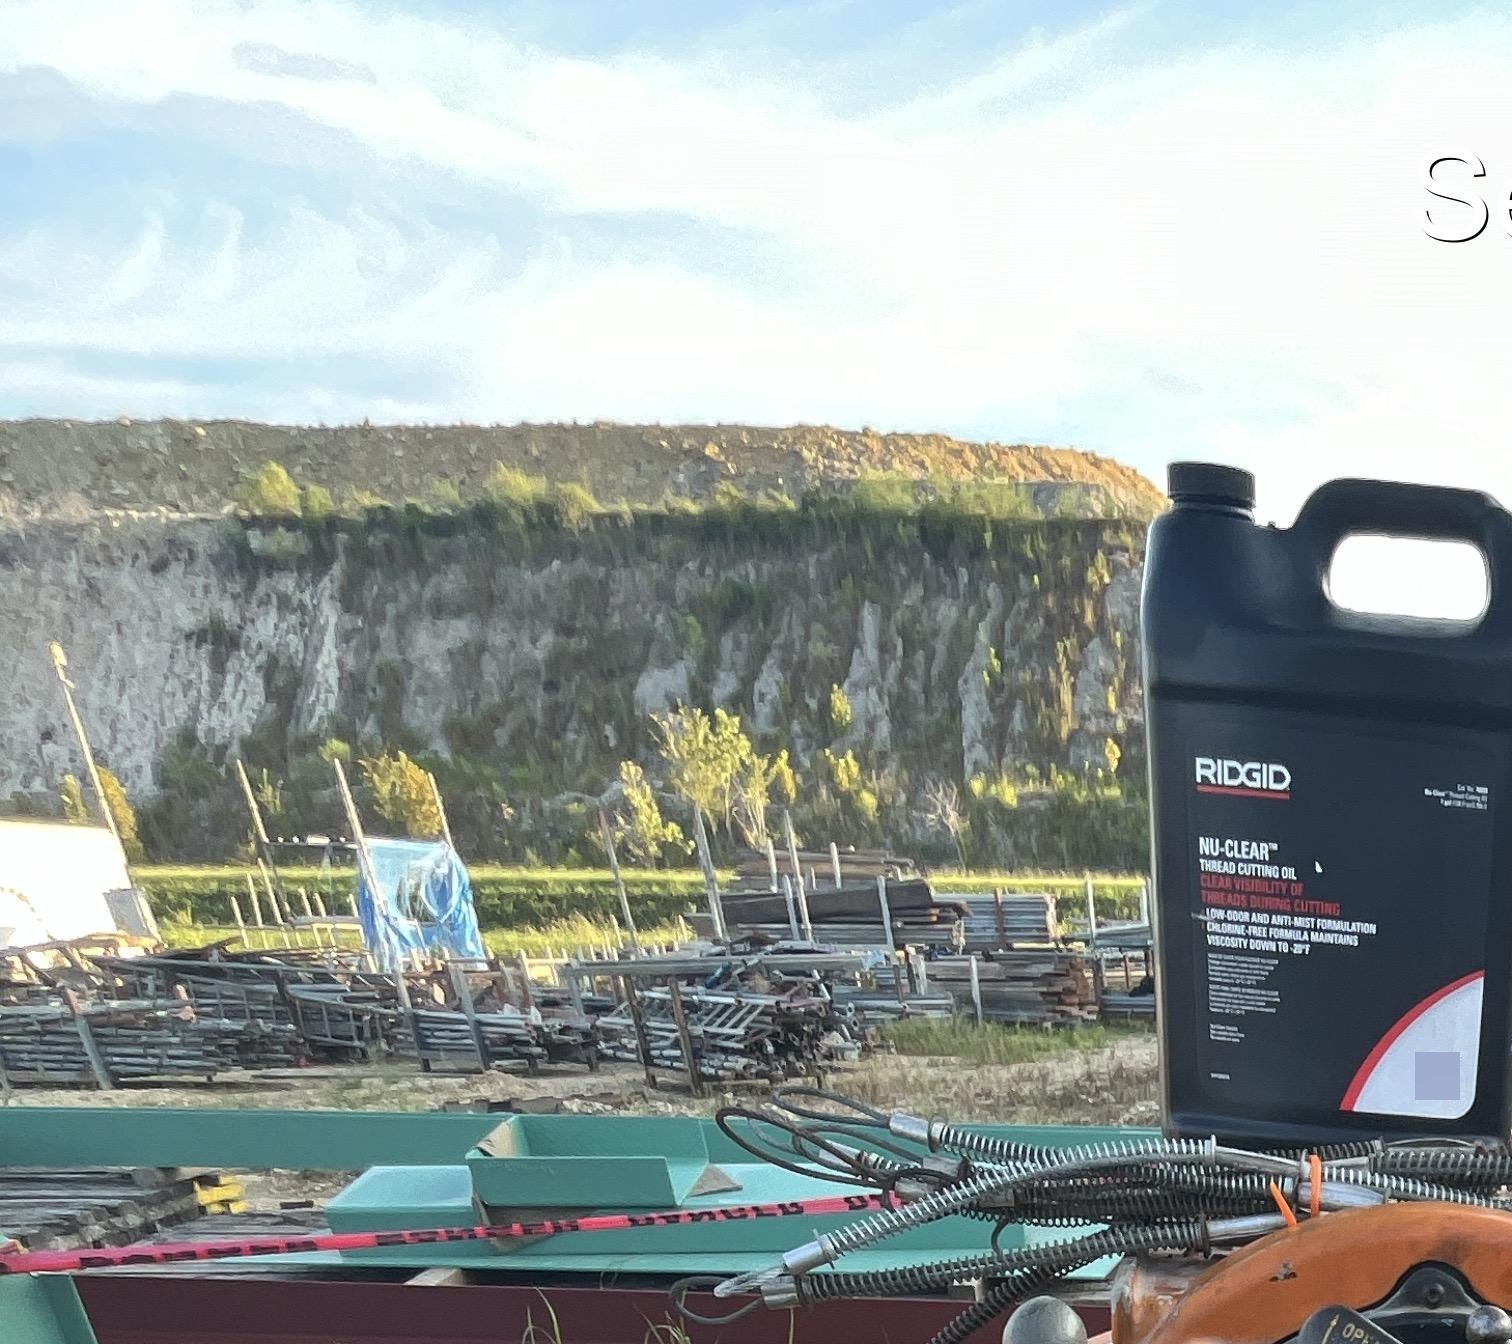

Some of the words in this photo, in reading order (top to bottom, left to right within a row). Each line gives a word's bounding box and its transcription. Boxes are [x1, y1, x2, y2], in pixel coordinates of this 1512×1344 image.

[1195, 757, 1291, 791] RIDGID
[1199, 858, 1235, 875] THREAD
[1238, 861, 1279, 879] CUTTING
[1281, 866, 1297, 880] OIL
[1200, 873, 1234, 890] CLEAR
[1235, 877, 1288, 895] VISIBILITY
[1201, 889, 1248, 907] THREADS
[1250, 893, 1291, 911] DURING
[1293, 899, 1342, 917] CUTTING
[1206, 907, 1249, 923] LOW-ODOR
[1251, 912, 1269, 925] AND
[1271, 914, 1315, 930] ANTI-MIST
[1316, 918, 1377, 935] FORMULATION
[1207, 921, 1267, 938] CHLORINE-FREE
[1269, 926, 1309, 942] FORMULA
[1310, 931, 1359, 947] MAINTAINS
[1207, 935, 1248, 950] VISCOSITY
[1250, 938, 1276, 953] DOWN
[1277, 940, 1289, 953] TO
